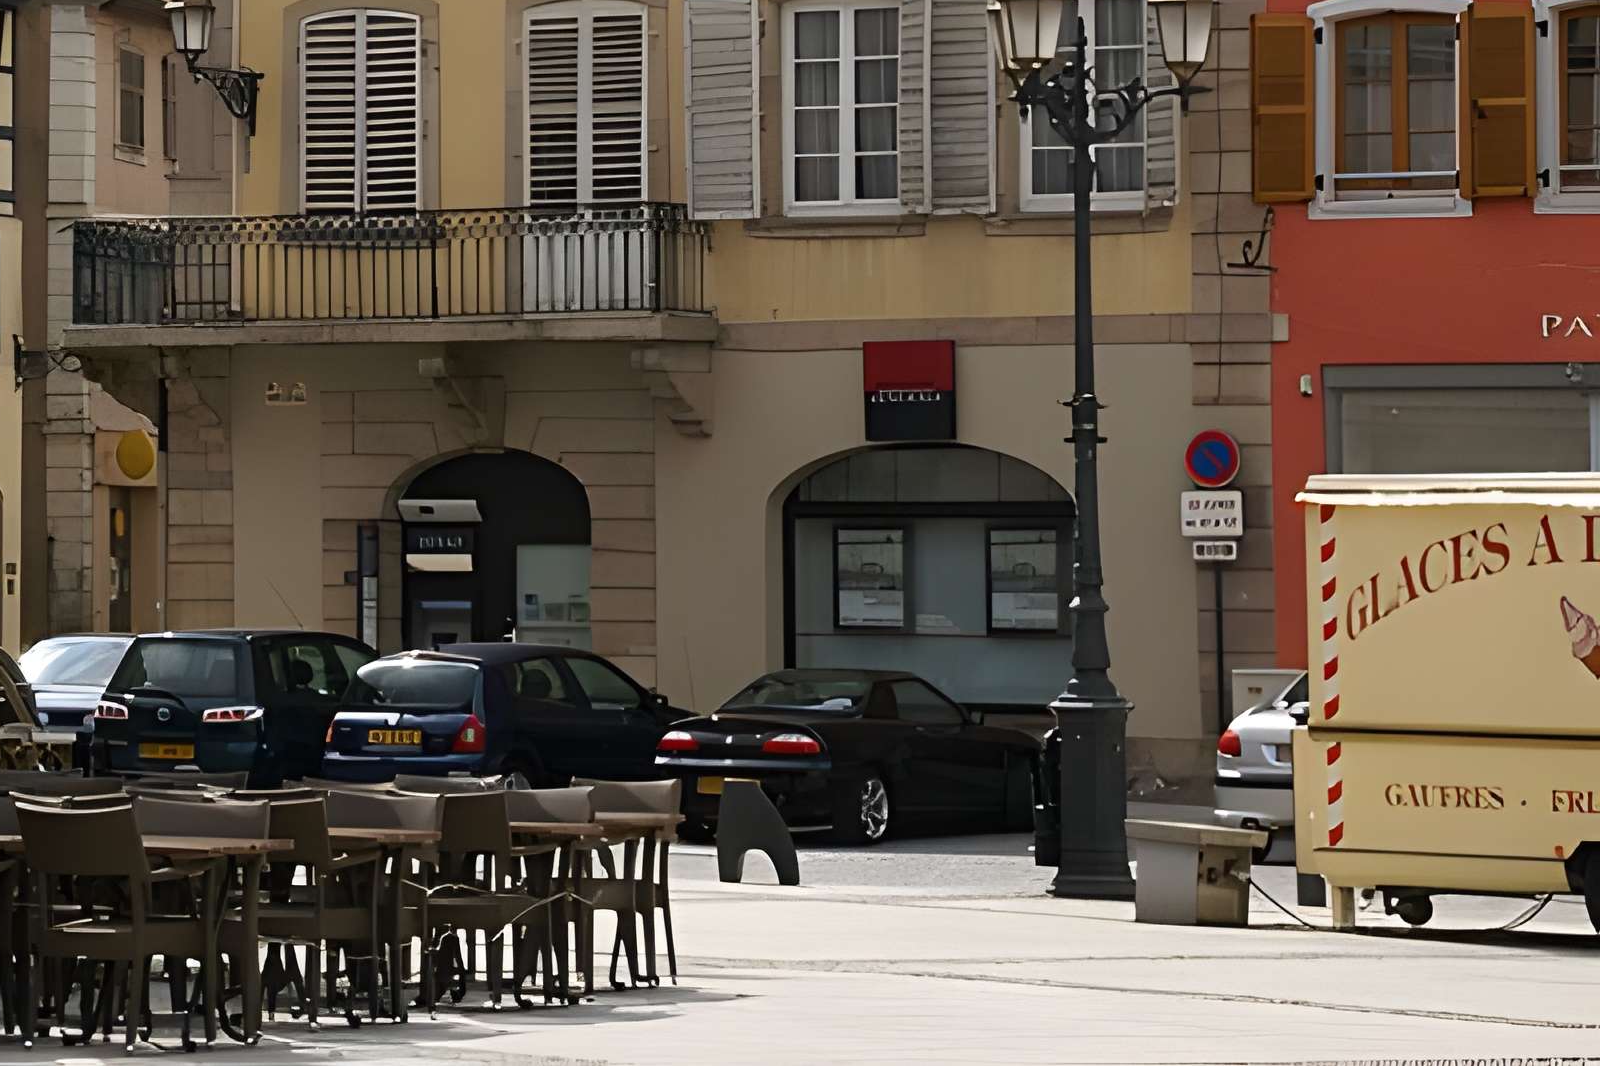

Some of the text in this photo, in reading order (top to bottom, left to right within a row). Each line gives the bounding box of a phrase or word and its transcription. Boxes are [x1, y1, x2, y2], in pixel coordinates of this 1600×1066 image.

[1542, 314, 1600, 337] PA
[1346, 522, 1510, 641] GLACES
[1385, 783, 1505, 810] GAUFRES
